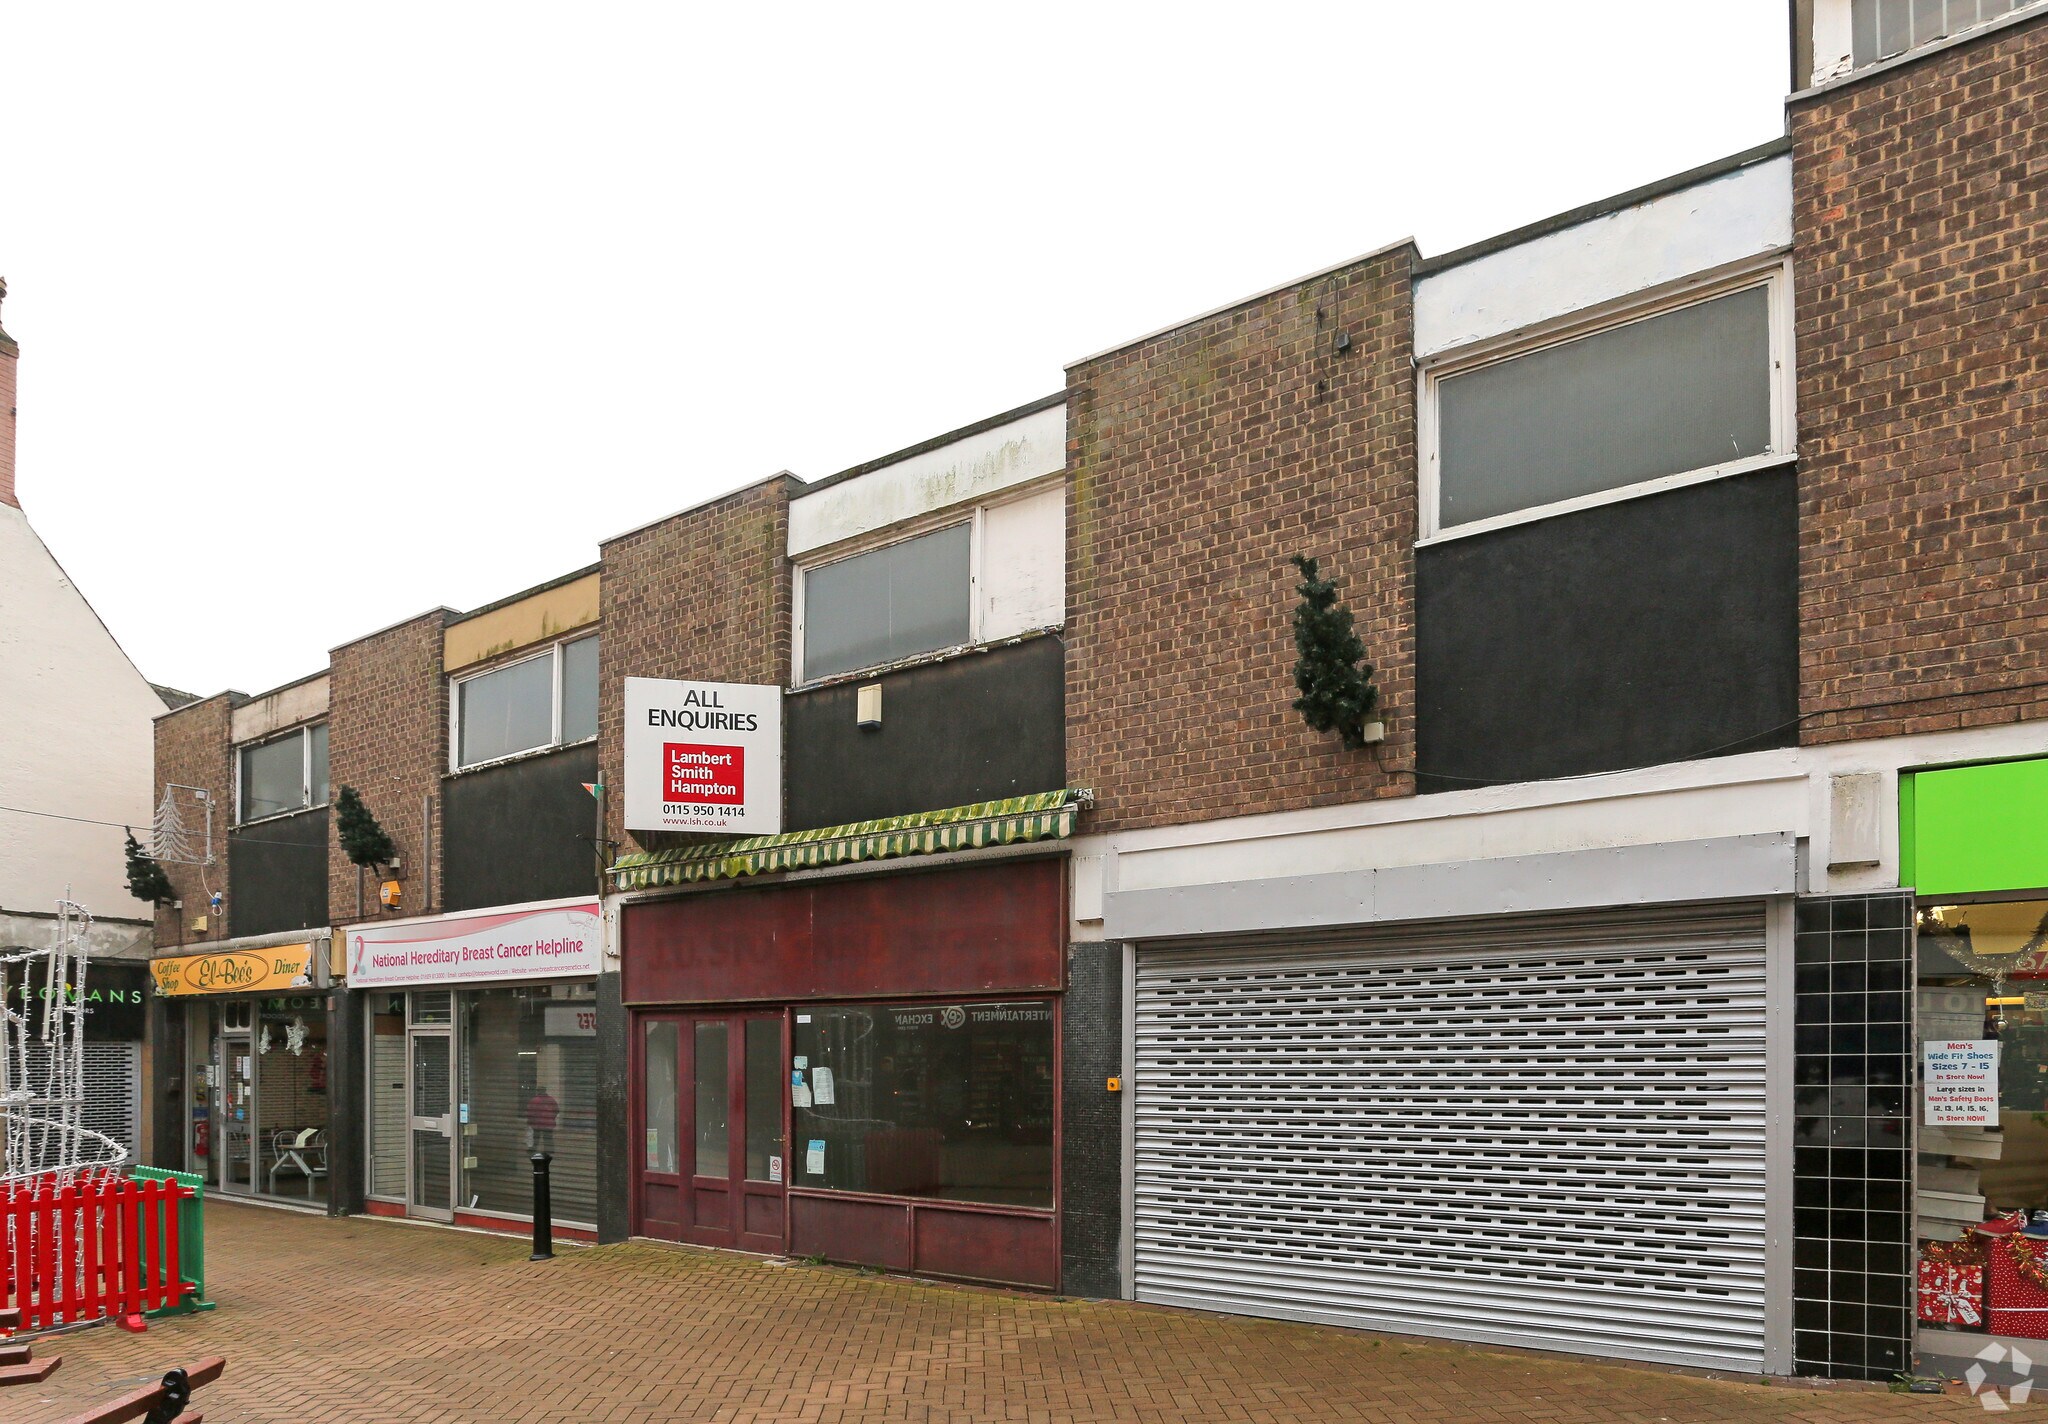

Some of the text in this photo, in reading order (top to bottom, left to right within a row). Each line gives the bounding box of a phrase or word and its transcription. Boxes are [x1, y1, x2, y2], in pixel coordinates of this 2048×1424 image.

[683, 689, 724, 708] ALL
[648, 708, 758, 731] ENQUIRIES
[671, 749, 732, 765] Lambert
[671, 764, 713, 780] Smith
[671, 779, 736, 797] Hampton
[663, 804, 746, 817] 0115 950 1414
[663, 817, 727, 827] www.lsh.co.uk
[372, 938, 583, 968] National Hereditary Breast Cancer Helpline
[157, 960, 181, 976] Coffee
[199, 958, 253, 987] El-Bee's
[273, 958, 301, 975] Diner
[161, 977, 179, 991] Shop
[1947, 1042, 1973, 1050] Men's
[1967, 1052, 1994, 1060] Shoes
[1961, 1062, 1968, 1070] 7
[1979, 1062, 1990, 1070] 15
[1936, 1086, 1956, 1094] Large
[1949, 1095, 1972, 1104] Safety
